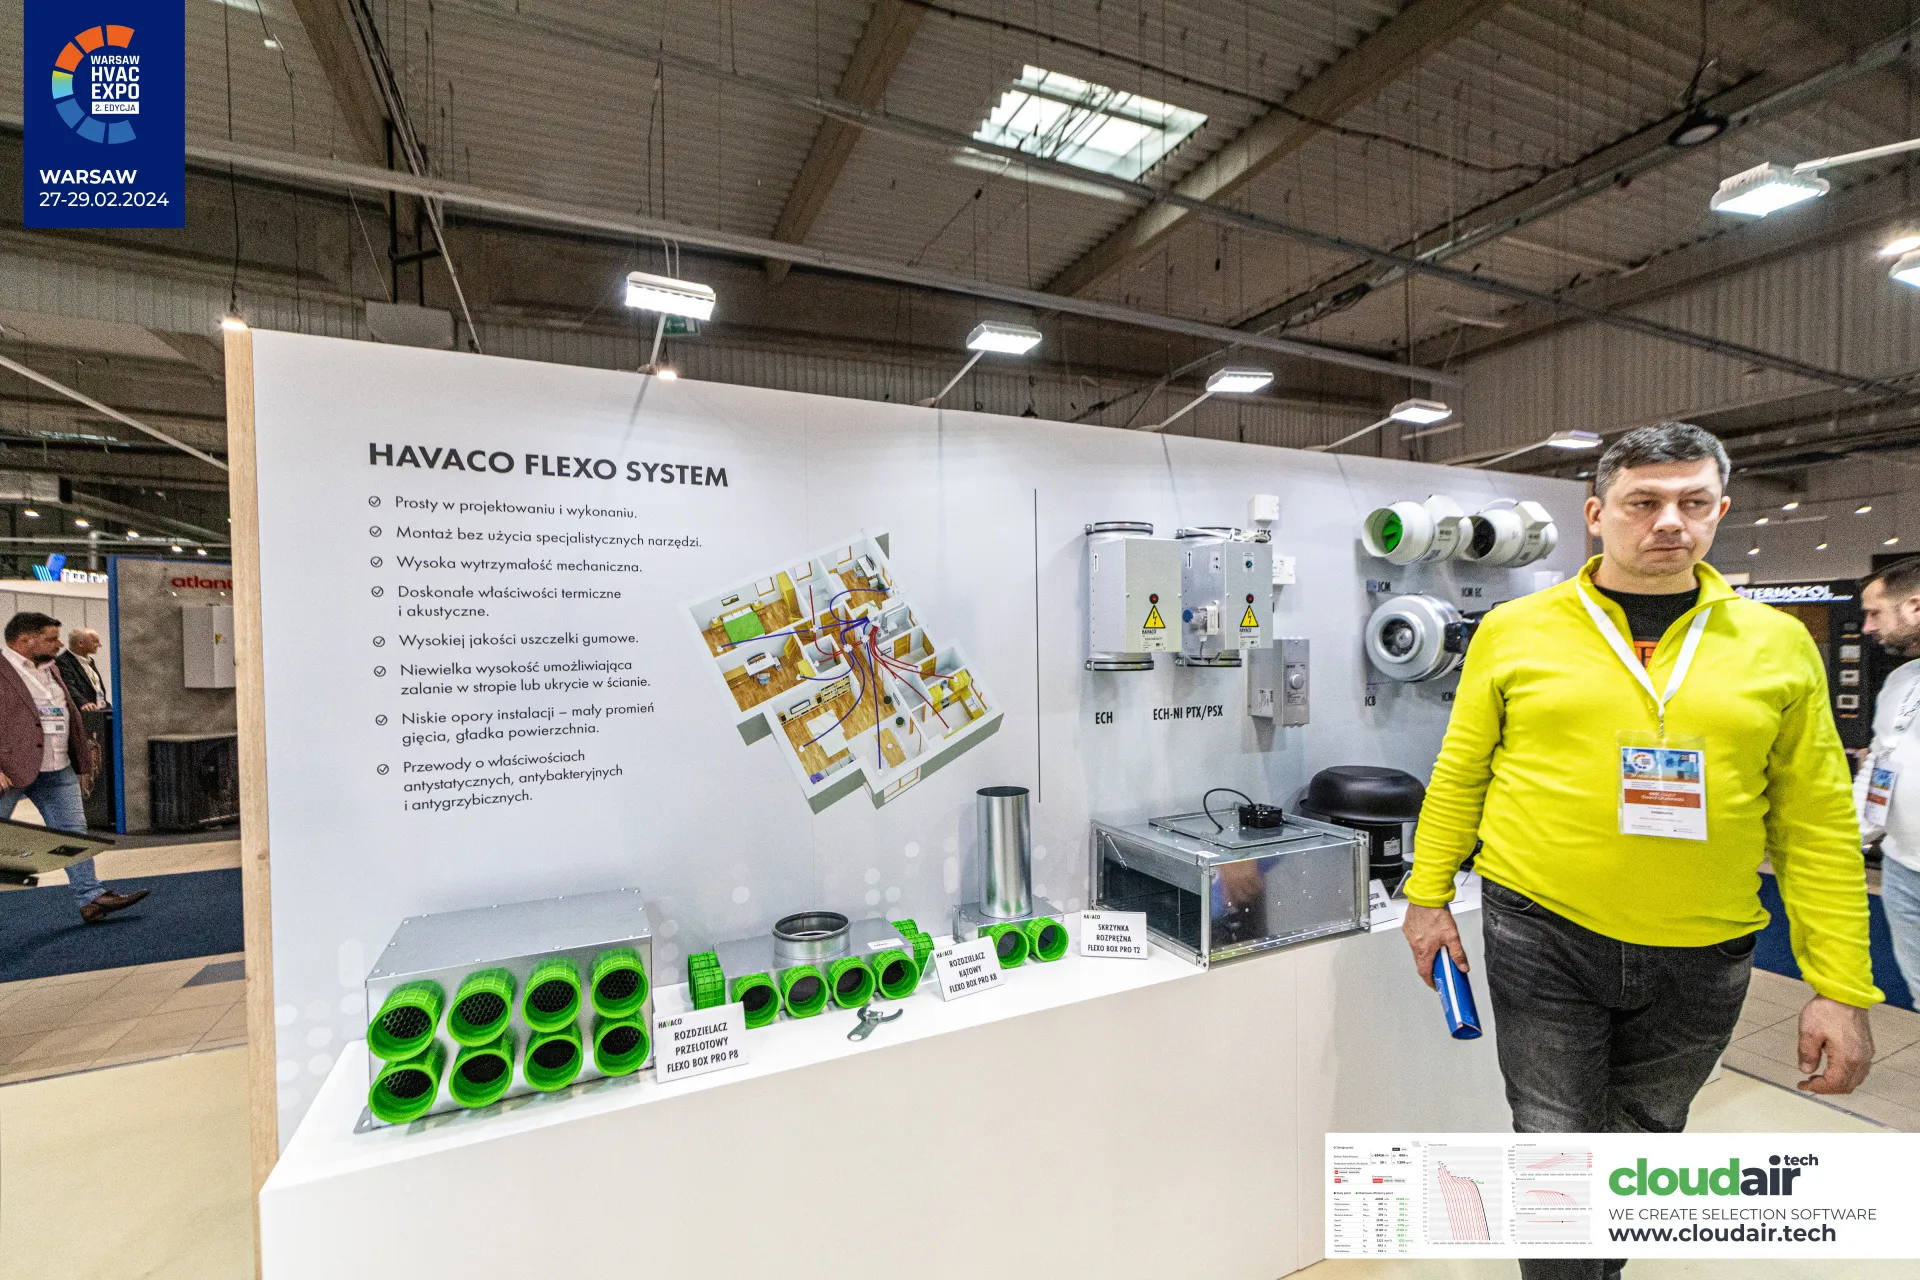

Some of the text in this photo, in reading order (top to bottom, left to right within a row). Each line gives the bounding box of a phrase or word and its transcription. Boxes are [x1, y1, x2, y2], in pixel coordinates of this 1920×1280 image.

[370, 443, 728, 487] HAVACO FLEXO SYSTEM
[396, 496, 636, 519] Prosty w projektowaniu i wykonaniu.
[397, 526, 701, 549] Montaż bez użycia specjalistycznych narzędzi.
[397, 556, 642, 573] Wysoka wytrzymałość mechaniczna.
[399, 585, 621, 598] Doskonałe właściwości termiczne
[398, 604, 489, 620] i akustyczne.
[399, 632, 638, 649] Wysokiej jakości uszczelki gumowe.
[401, 660, 631, 677] Niewielka wysokość umożliwiająca
[401, 682, 452, 695] zalanie
[474, 681, 516, 695] stropie
[521, 679, 540, 690] lub
[545, 678, 588, 692] ukrycie
[607, 677, 650, 687] ścianie.
[1365, 696, 1376, 706] ICB
[403, 711, 446, 724] Niskie
[452, 713, 493, 725] opory
[498, 707, 554, 721] instalacji
[572, 704, 601, 718] mały
[606, 703, 654, 718] promień
[1096, 711, 1113, 724] ECH
[1154, 705, 1223, 720] ECH-NI PTX/PSX
[402, 723, 599, 747] gięcia, gładka powierzchnia.
[404, 757, 471, 773] Przewody
[488, 750, 584, 767] właściwościach
[404, 765, 622, 793] antystatycznych, antybakteryjnych
[404, 789, 532, 812] i antygrzybicznych.
[1096, 934, 1131, 943] ROZPRĘŻNA
[936, 950, 952, 958] HAVACO
[949, 952, 985, 968] ROZDZIELACZ
[959, 965, 982, 977] KĄTOWY
[949, 973, 997, 993] FLEXO BOX PRO K8
[658, 1019, 682, 1028] HAVACO
[675, 1022, 727, 1041] ROZDZIELACZ
[676, 1037, 728, 1055] PRZELOTOWY
[667, 1050, 738, 1073] FLEXO BOX PRO P8
